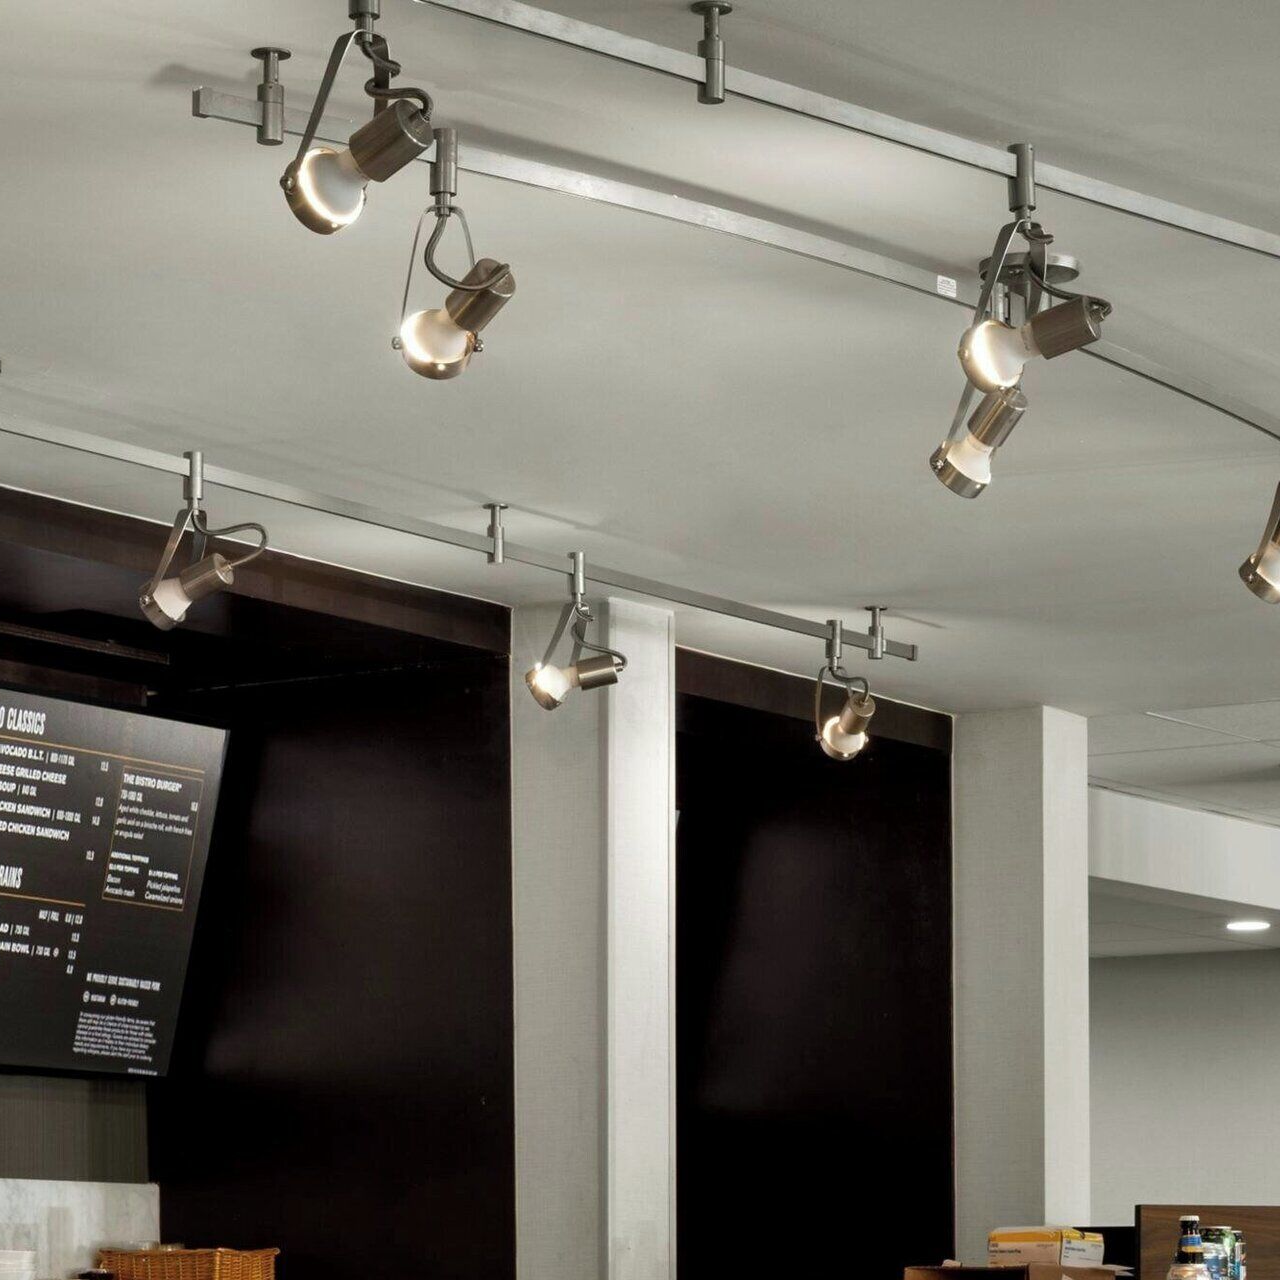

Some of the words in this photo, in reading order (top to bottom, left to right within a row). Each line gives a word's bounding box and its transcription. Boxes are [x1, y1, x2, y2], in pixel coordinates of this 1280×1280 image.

[7, 708, 46, 735] CLASSICS
[28, 749, 44, 760] B.L.T.
[15, 767, 41, 780] GRILLED
[42, 771, 67, 785] CHEESE
[124, 773, 135, 784] THE
[135, 775, 156, 788] BISTRO
[17, 804, 51, 818] SANDWICH
[8, 822, 36, 835] CHICKEN
[36, 826, 69, 840] SANDWICH
[11, 943, 29, 954] BOWL
